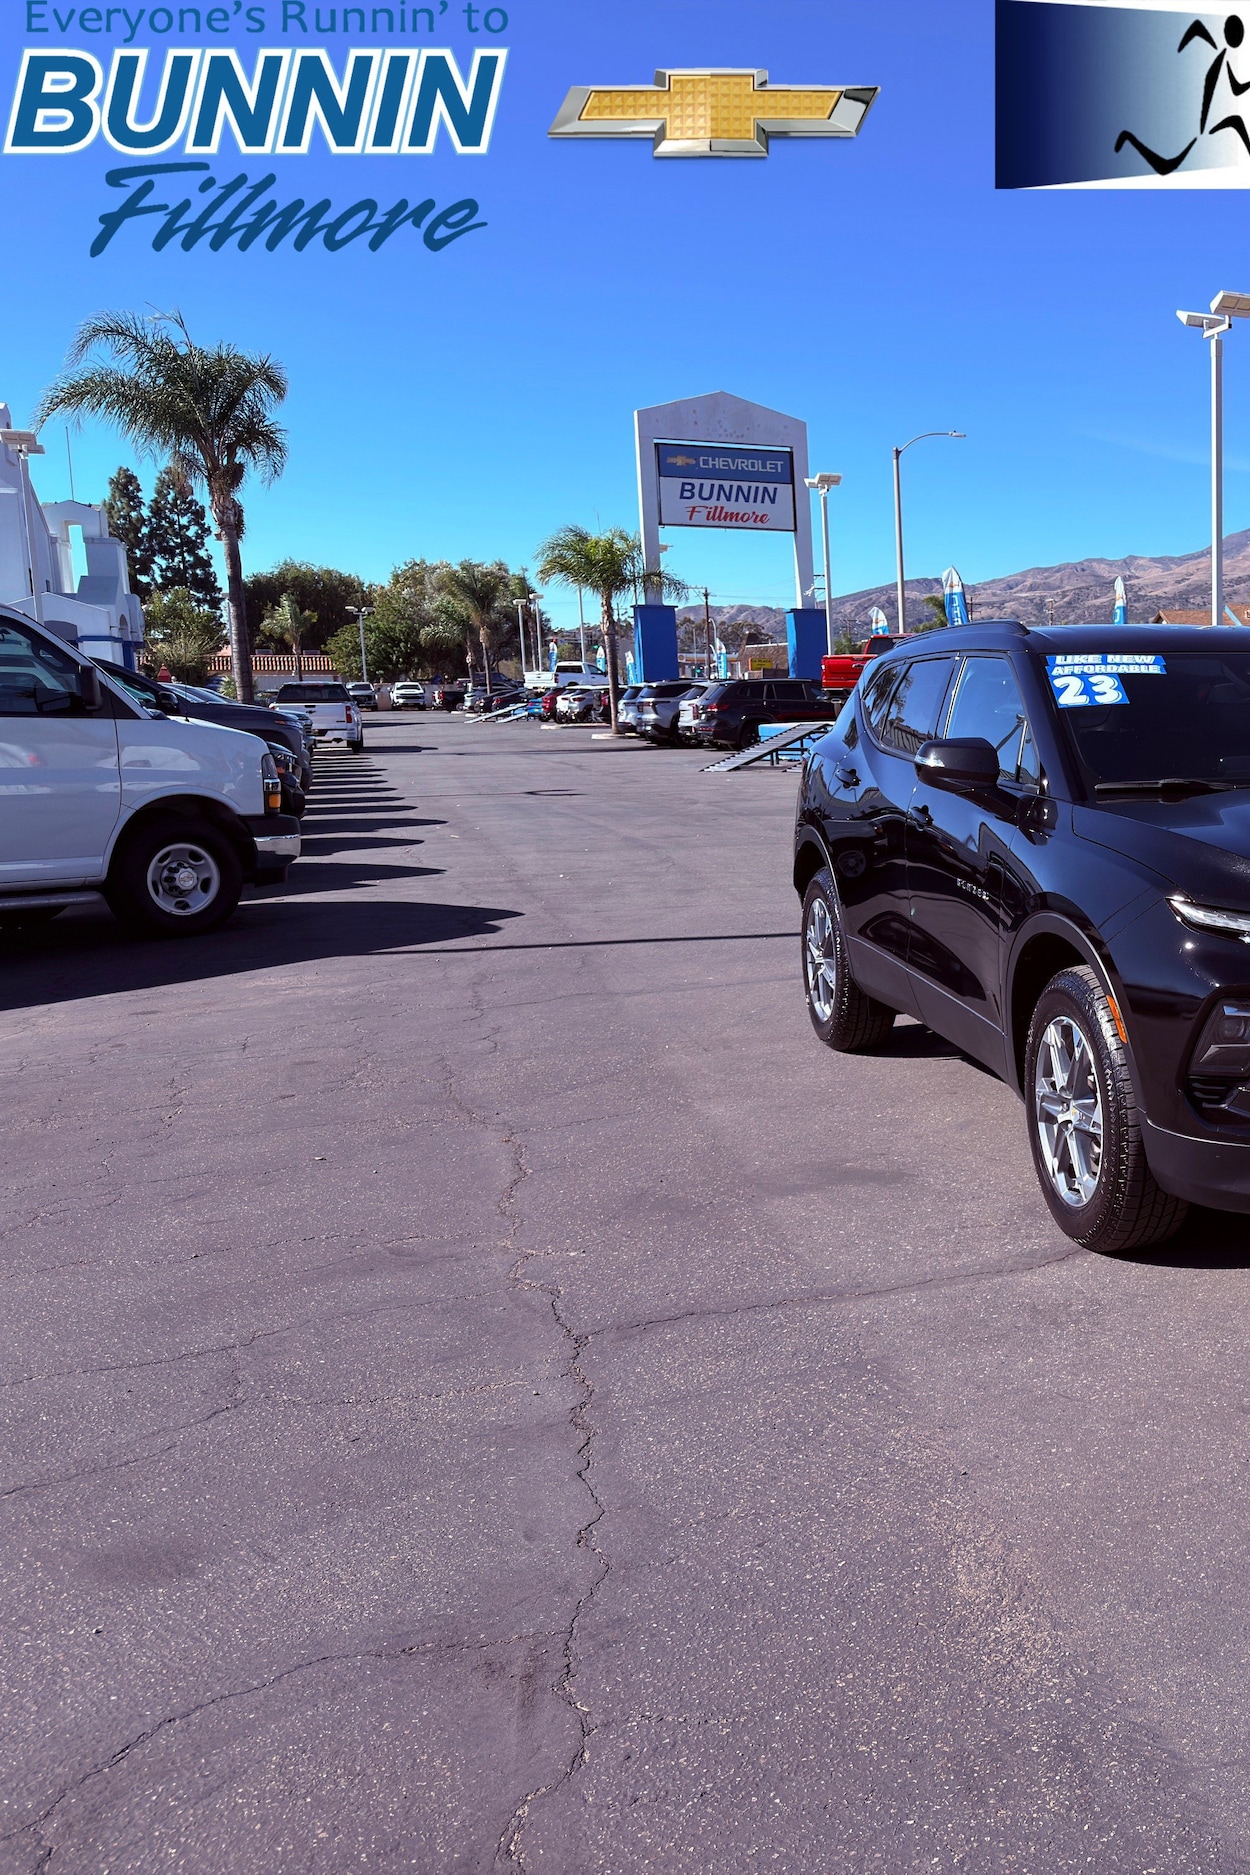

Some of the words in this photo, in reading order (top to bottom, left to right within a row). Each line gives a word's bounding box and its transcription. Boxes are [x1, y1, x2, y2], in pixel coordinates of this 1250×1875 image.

[699, 456, 784, 472] CHEVROLET
[679, 482, 778, 504] BUNNIN
[685, 505, 770, 525] Fillmore
[1055, 655, 1102, 664] LIKE
[1107, 655, 1156, 664] NEW
[1052, 665, 1161, 675] AFFORDABLE
[1053, 675, 1122, 705] 23
